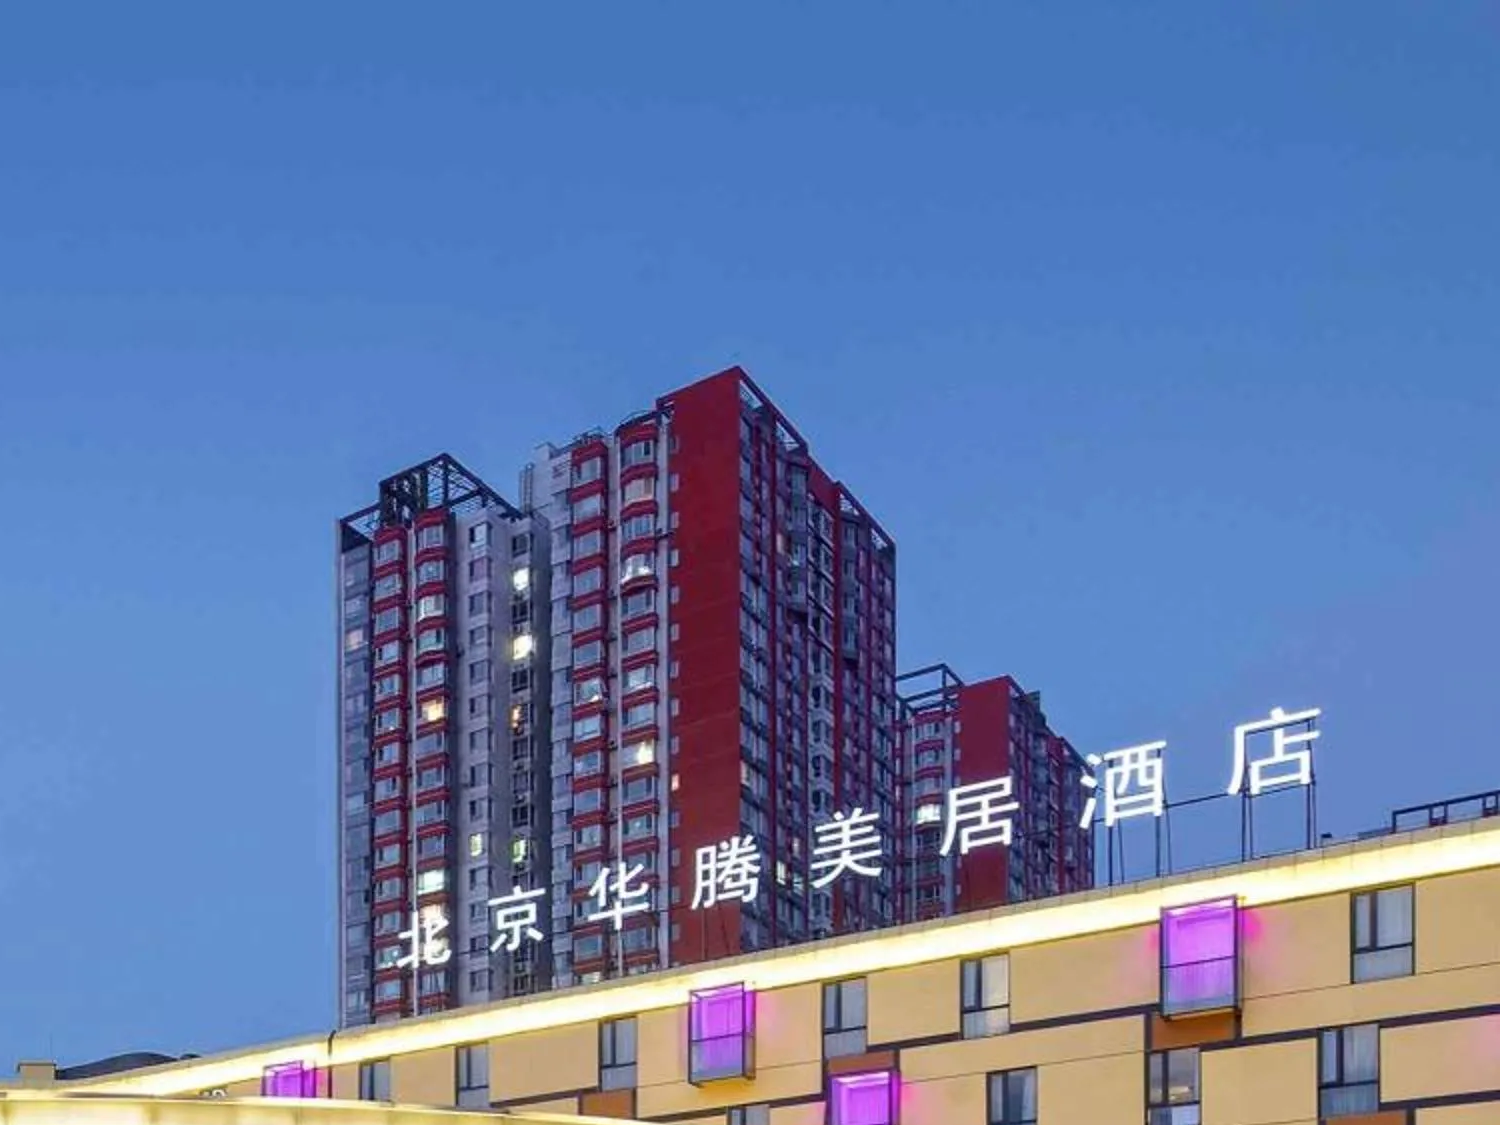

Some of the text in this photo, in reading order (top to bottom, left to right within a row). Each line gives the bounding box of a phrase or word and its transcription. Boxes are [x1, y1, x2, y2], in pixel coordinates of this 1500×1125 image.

[396, 706, 1322, 970] 北京华腾美居酒店
